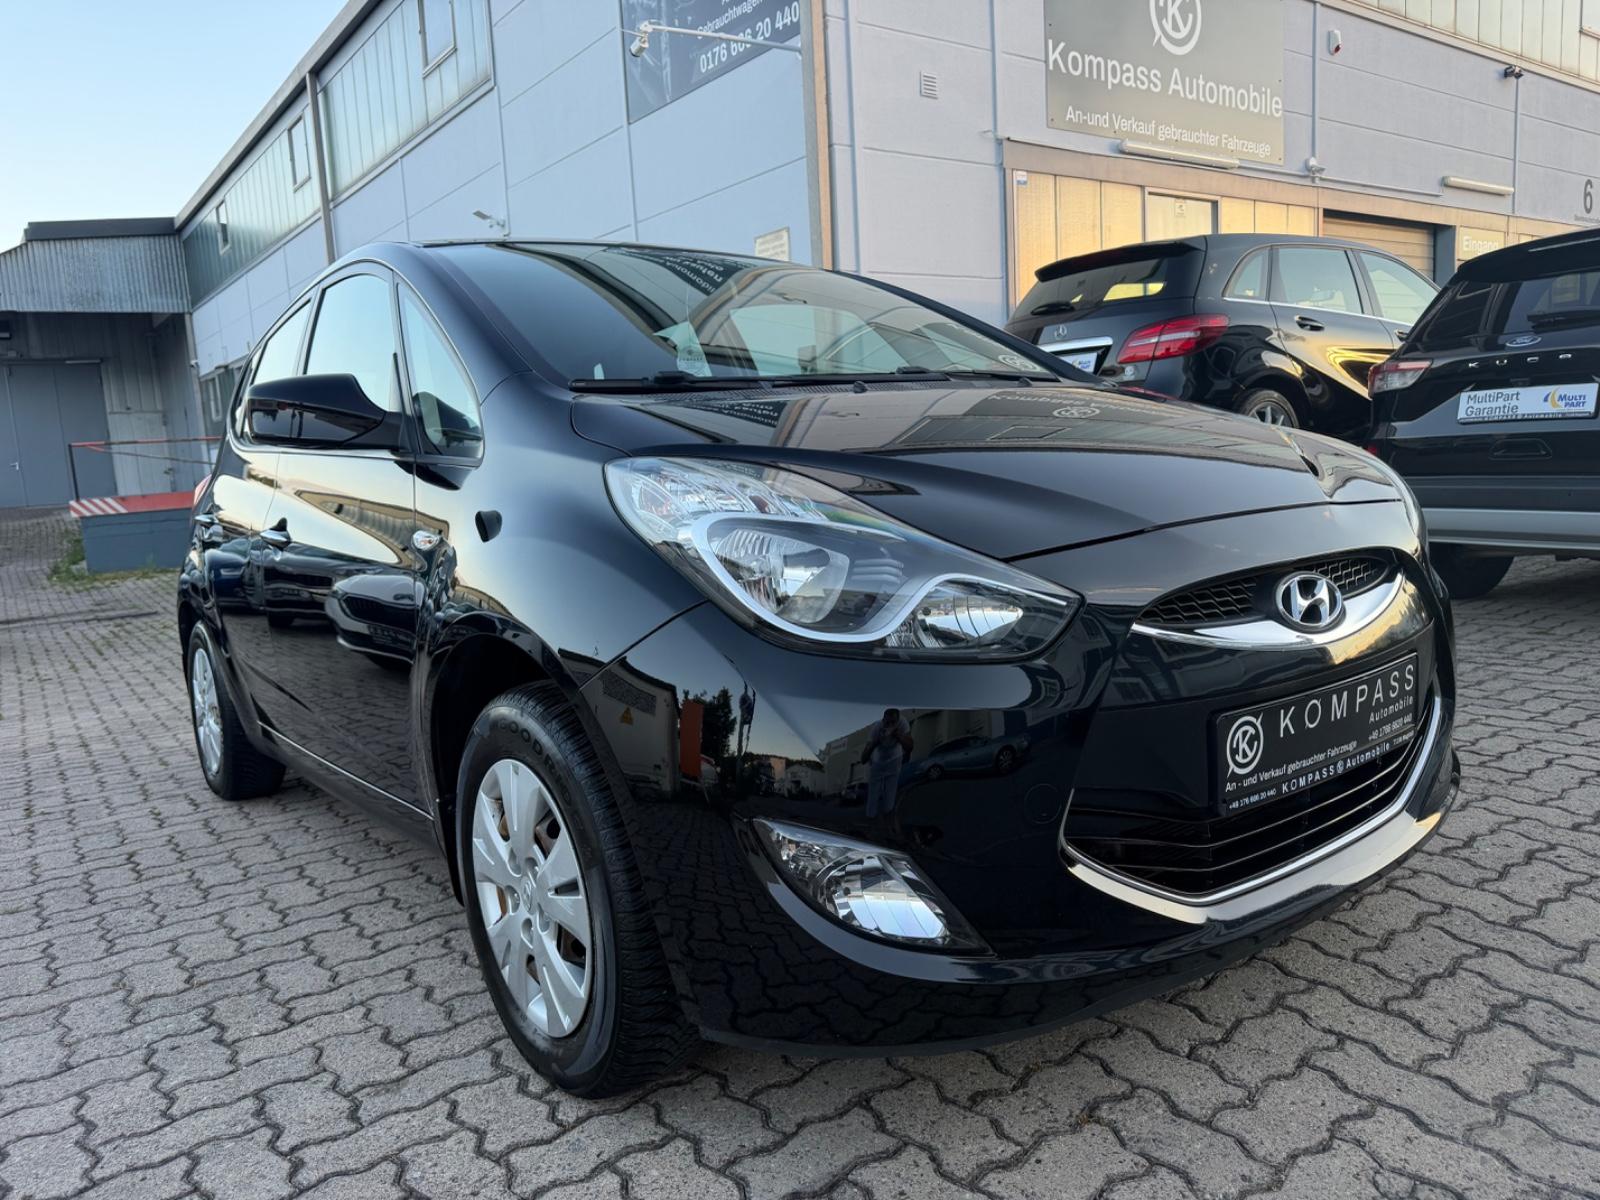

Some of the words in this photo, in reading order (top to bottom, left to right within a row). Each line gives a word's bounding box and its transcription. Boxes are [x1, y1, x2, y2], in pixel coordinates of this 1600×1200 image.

[700, 42, 728, 73] 0176
[755, 17, 771, 41] 20
[775, 1, 799, 30] 440
[1048, 39, 1162, 92] Kompass
[1168, 68, 1283, 117] Automobile
[1065, 105, 1109, 128] An-und
[1112, 115, 1156, 137] Verkauf
[1158, 123, 1220, 148] gebrauchter
[1221, 134, 1271, 158] Fahrzeuge
[1583, 179, 1593, 214] 6
[1465, 402, 1519, 417] Garantie
[1467, 391, 1520, 405] MultiPart
[1279, 664, 1415, 738] KOMPASS
[1368, 694, 1414, 725] Automobile
[1225, 782, 1237, 792] An
[1243, 773, 1258, 787] und
[1259, 764, 1287, 781] Verkauf
[1287, 751, 1327, 774] gebrauchter
[1327, 740, 1358, 758] Fahrzeuge
[1282, 764, 1335, 795] KOMPASS
[1346, 742, 1390, 769] Automobile
